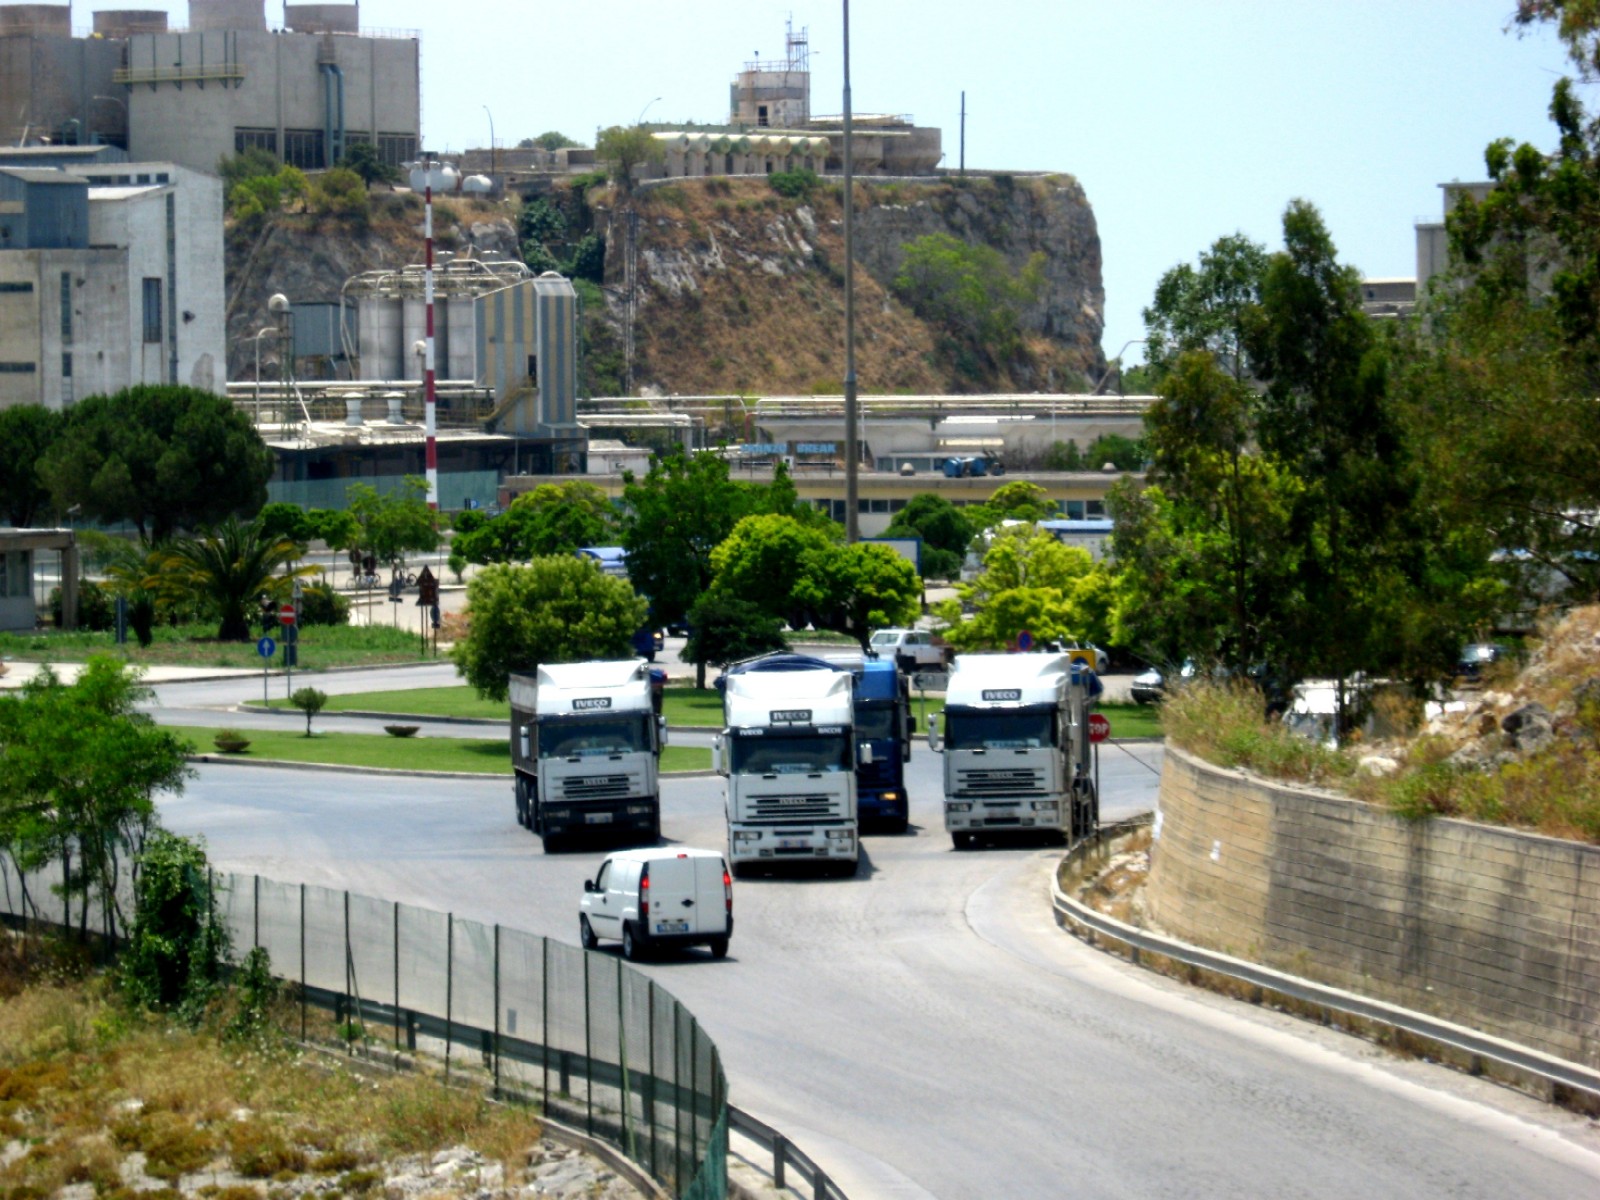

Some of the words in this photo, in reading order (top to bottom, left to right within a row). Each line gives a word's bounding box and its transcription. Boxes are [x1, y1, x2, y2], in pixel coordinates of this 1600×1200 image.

[797, 443, 836, 453] BREAK
[985, 690, 1018, 699] IVECO
[576, 699, 608, 708] IVECO
[773, 711, 809, 720] IVECO
[740, 728, 764, 736] IVECO
[1089, 723, 1109, 735] TOP
